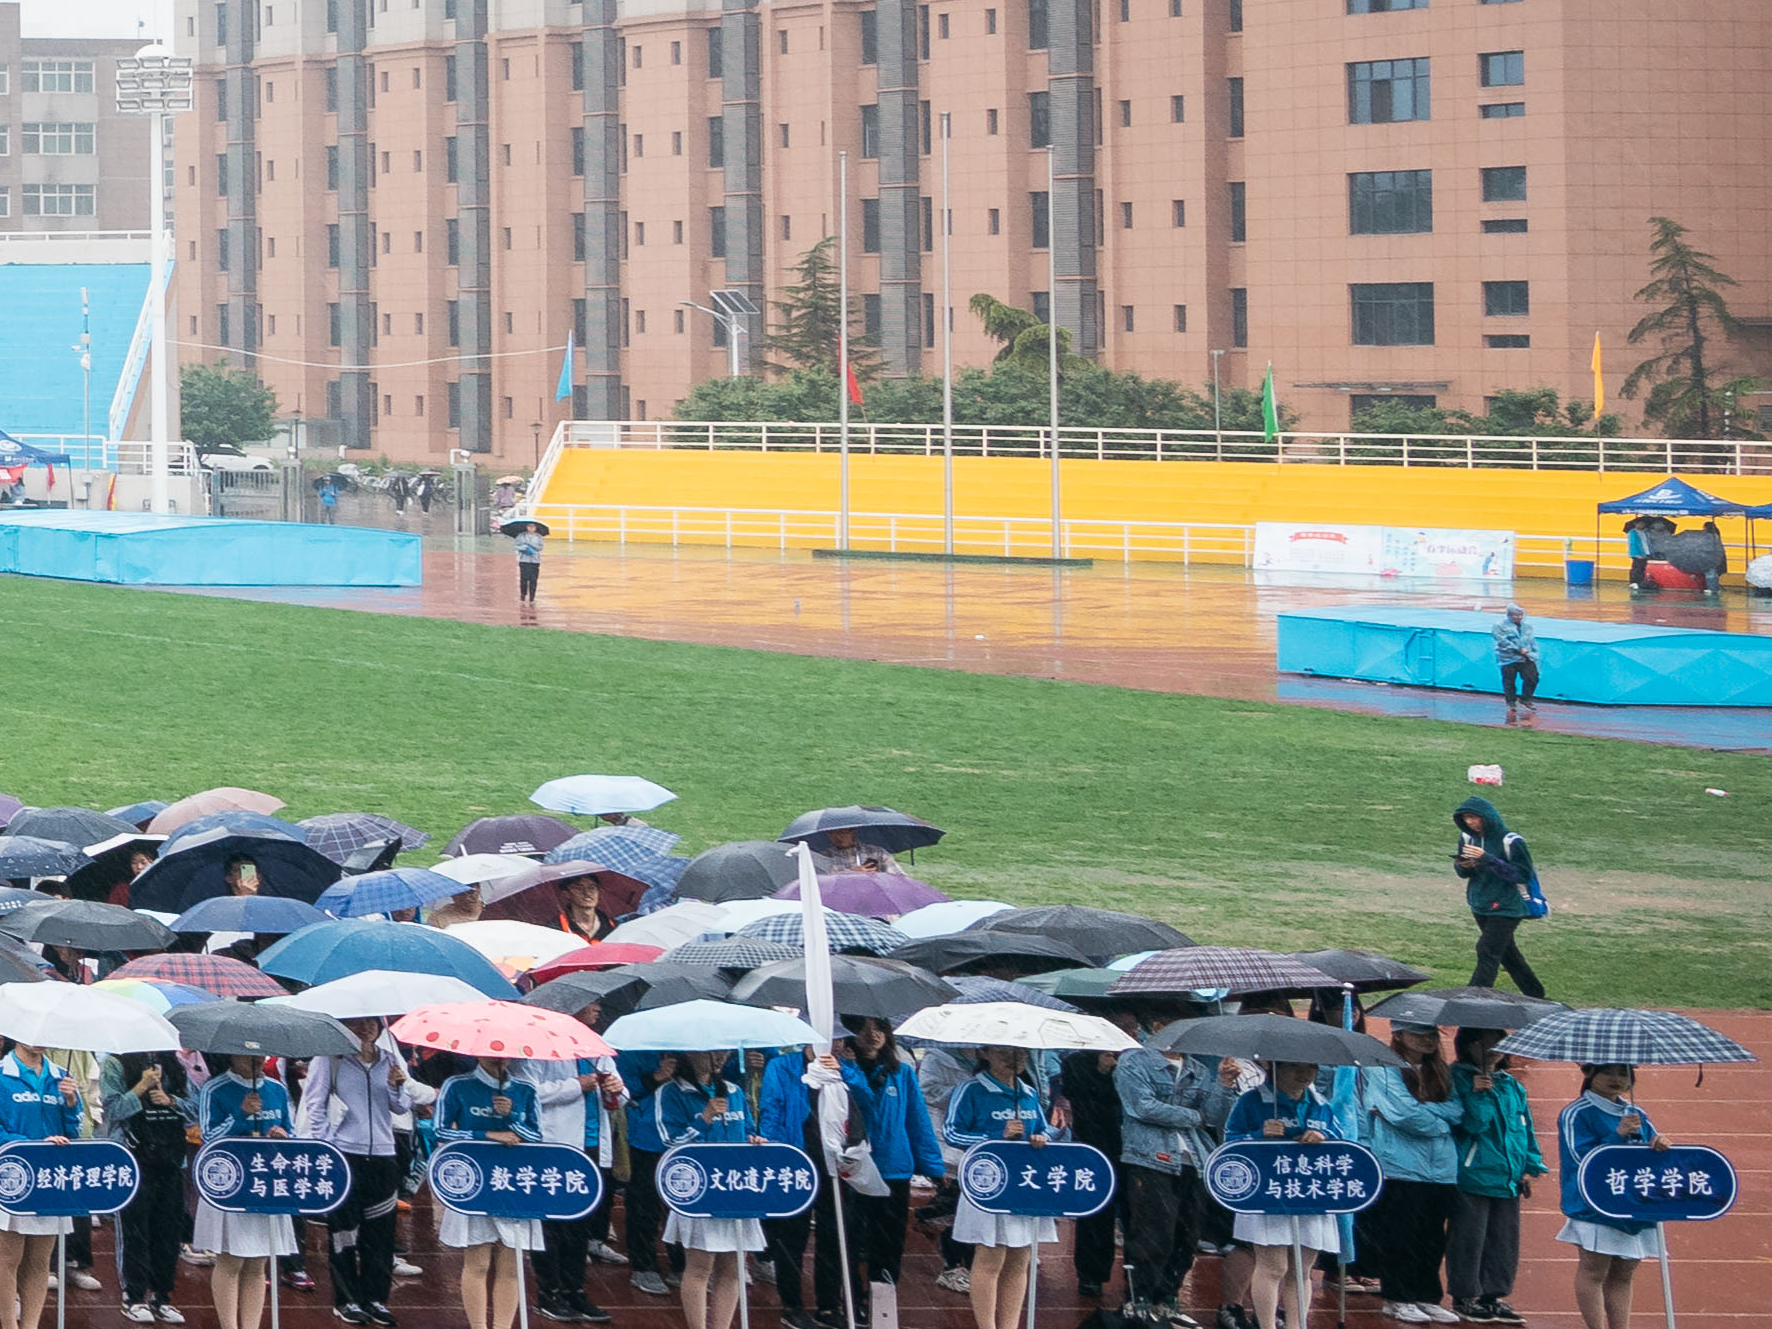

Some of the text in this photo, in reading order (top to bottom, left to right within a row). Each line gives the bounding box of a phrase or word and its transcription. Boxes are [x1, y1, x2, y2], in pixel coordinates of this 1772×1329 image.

[36, 1164, 134, 1191] 经济管理学院
[250, 1152, 334, 1176] 生命科学
[1272, 1153, 1354, 1176] 信息科学
[249, 1176, 334, 1200] 与医学部
[489, 1164, 589, 1196] 数学学院
[709, 1165, 812, 1193] 文化遗产学院
[1018, 1164, 1096, 1193] 文学院
[1265, 1177, 1366, 1200] 与技术学院
[1605, 1166, 1713, 1197] 哲学学院
